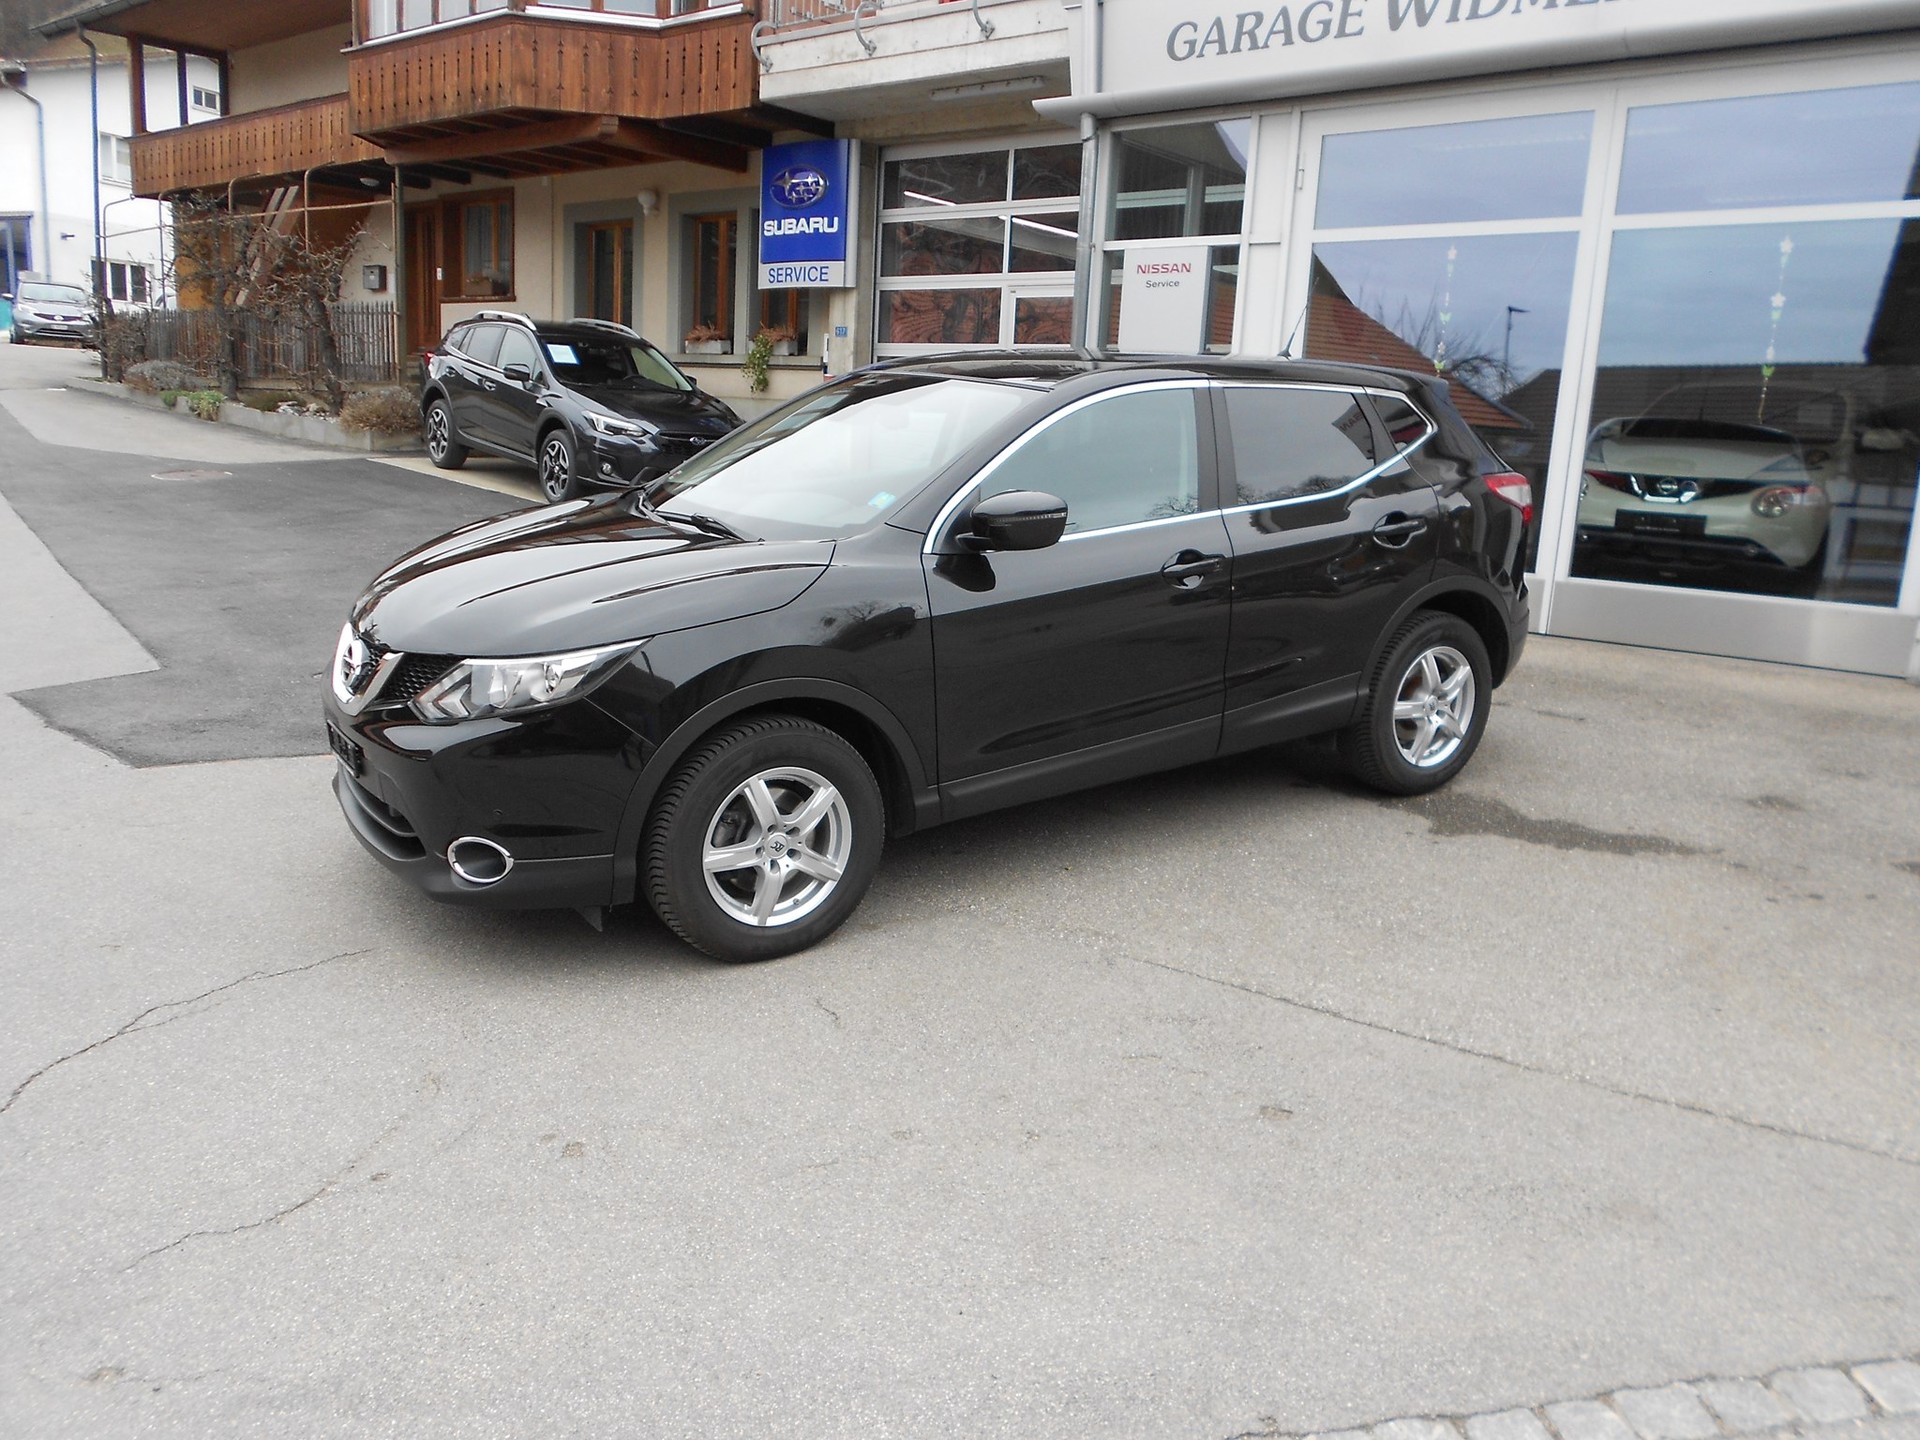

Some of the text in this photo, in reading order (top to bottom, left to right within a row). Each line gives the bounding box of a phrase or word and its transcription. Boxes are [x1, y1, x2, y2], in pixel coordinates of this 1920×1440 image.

[1166, 0, 1365, 62] GARAGE
[764, 217, 839, 236] SUBARU
[768, 266, 829, 284] SERVICE
[1136, 263, 1192, 274] NISSAN
[1145, 280, 1180, 288] Service
